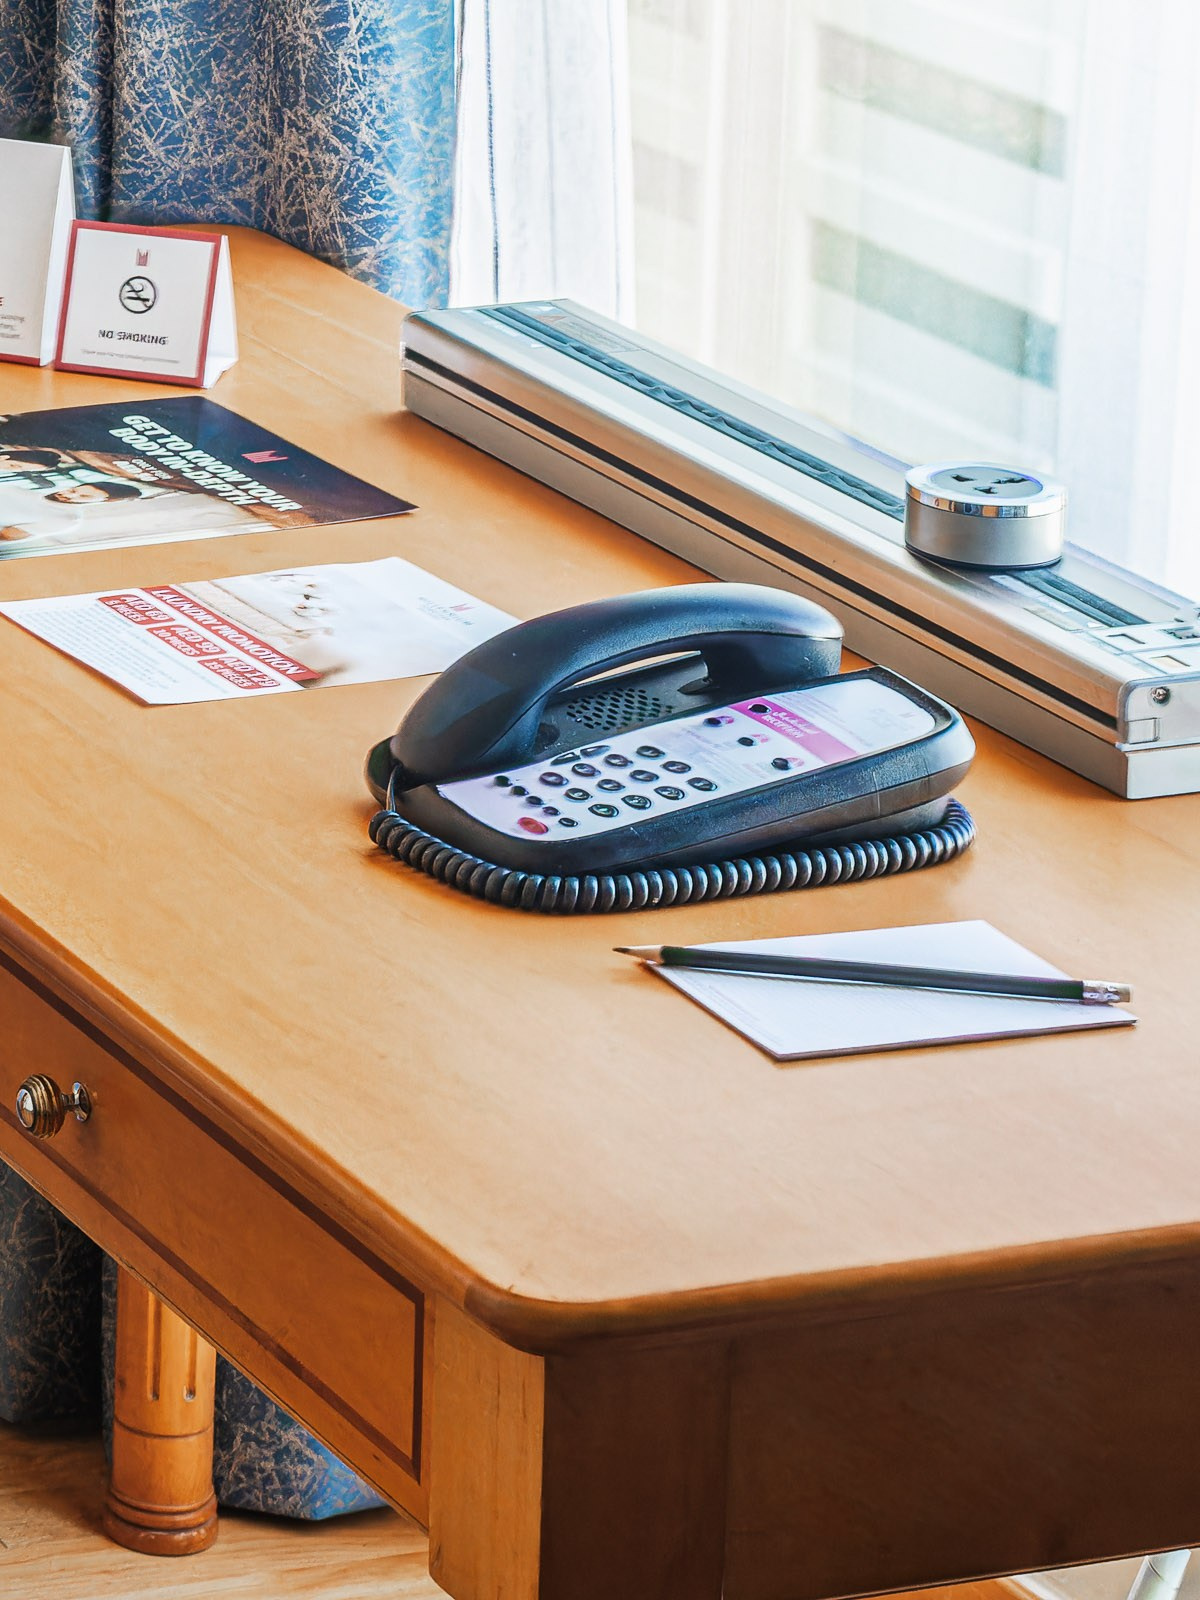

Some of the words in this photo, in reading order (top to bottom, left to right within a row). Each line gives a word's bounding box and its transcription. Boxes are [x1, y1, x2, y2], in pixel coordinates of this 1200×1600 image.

[98, 329, 114, 340] NO
[116, 331, 169, 346] SMOKING
[108, 427, 174, 456] BODY
[157, 454, 260, 506] IN-DEPTH
[122, 415, 171, 436] GET
[157, 434, 194, 451] TO
[179, 449, 253, 483] KNOW
[237, 481, 303, 512] YOUR
[111, 604, 150, 622] PIECES
[120, 597, 156, 611] AED
[144, 610, 171, 621] 69
[151, 589, 222, 626] LAUNDRY
[211, 624, 305, 676] PROMOTION
[152, 629, 172, 638] 10
[164, 636, 200, 655] PIECES
[170, 627, 204, 642] AED
[195, 641, 221, 653] 99
[204, 661, 224, 670] 15
[216, 668, 256, 687] PIECES
[218, 657, 256, 672] AED
